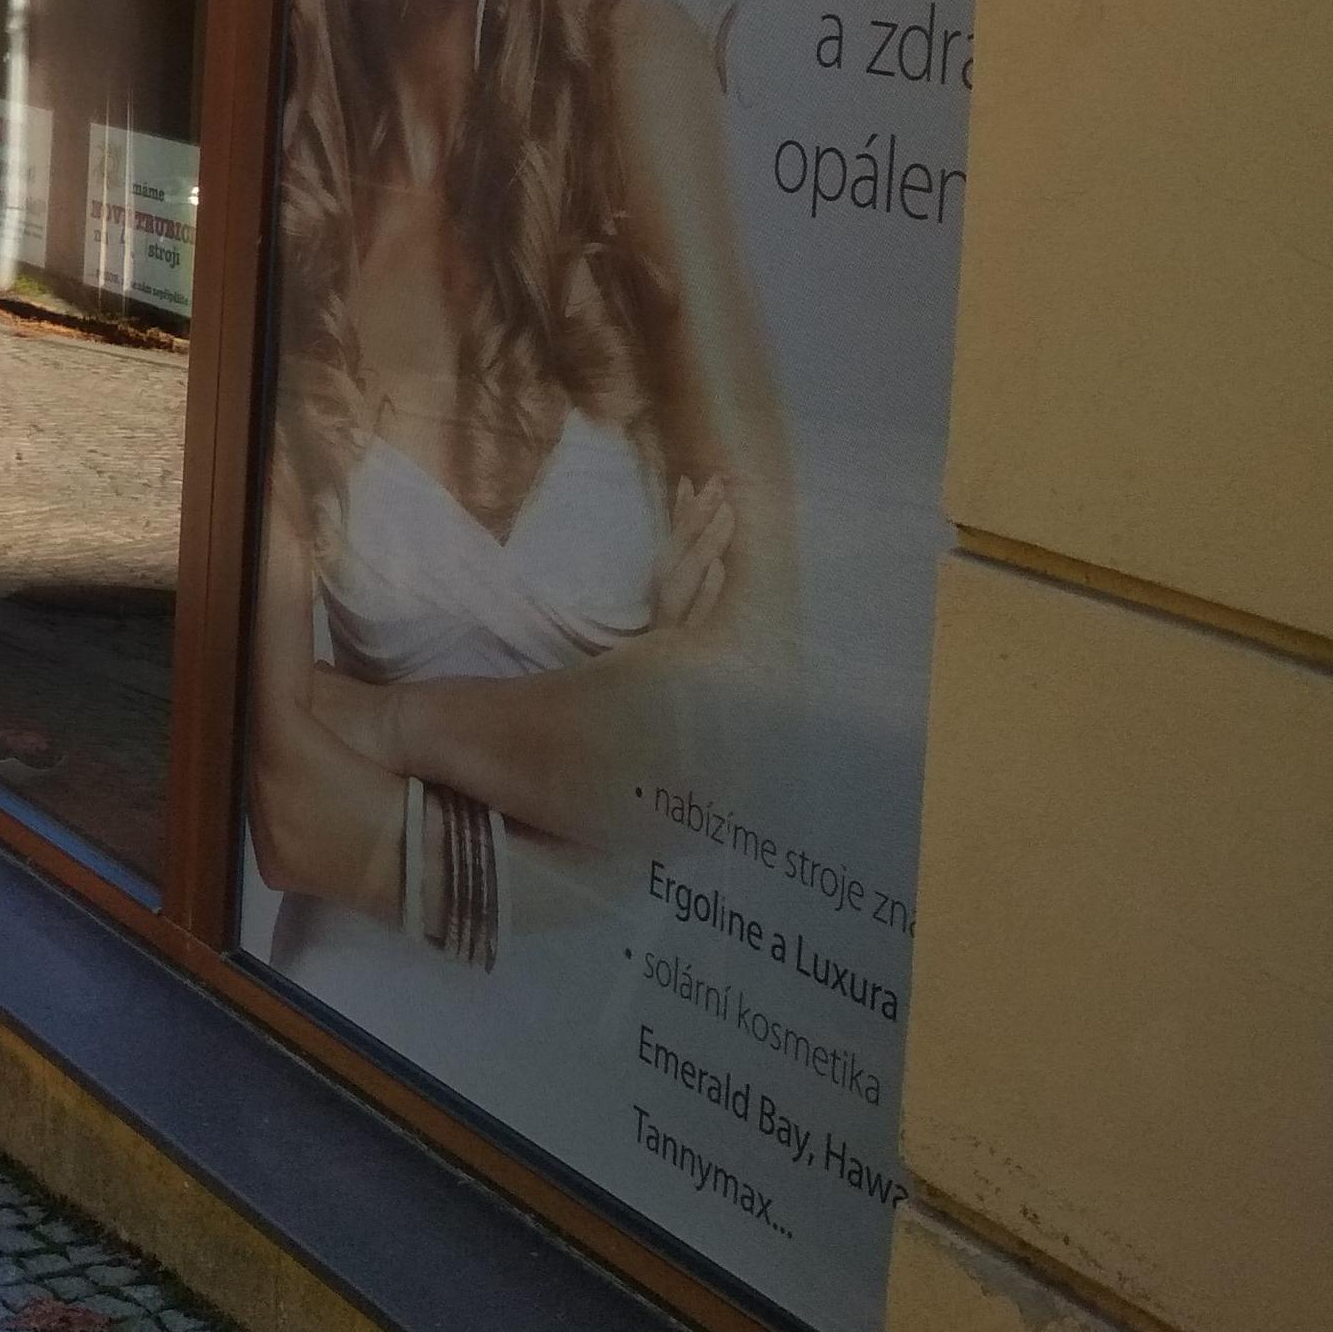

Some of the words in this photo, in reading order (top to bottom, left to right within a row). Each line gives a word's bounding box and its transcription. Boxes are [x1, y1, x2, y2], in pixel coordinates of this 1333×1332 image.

[815, 13, 844, 69] a
[90, 199, 133, 230] NOV
[654, 785, 778, 869] nabízíme
[784, 848, 866, 912] stroje
[871, 890, 917, 940] zn
[648, 859, 764, 951] Ergoline
[770, 931, 787, 964] a
[795, 933, 899, 1021] Luxura
[637, 1023, 751, 1122] Emerald
[758, 1094, 815, 1167] Bay,
[642, 951, 733, 1021] solární
[736, 991, 882, 1108] kosmetika
[632, 1104, 793, 1240] Tannymax...
